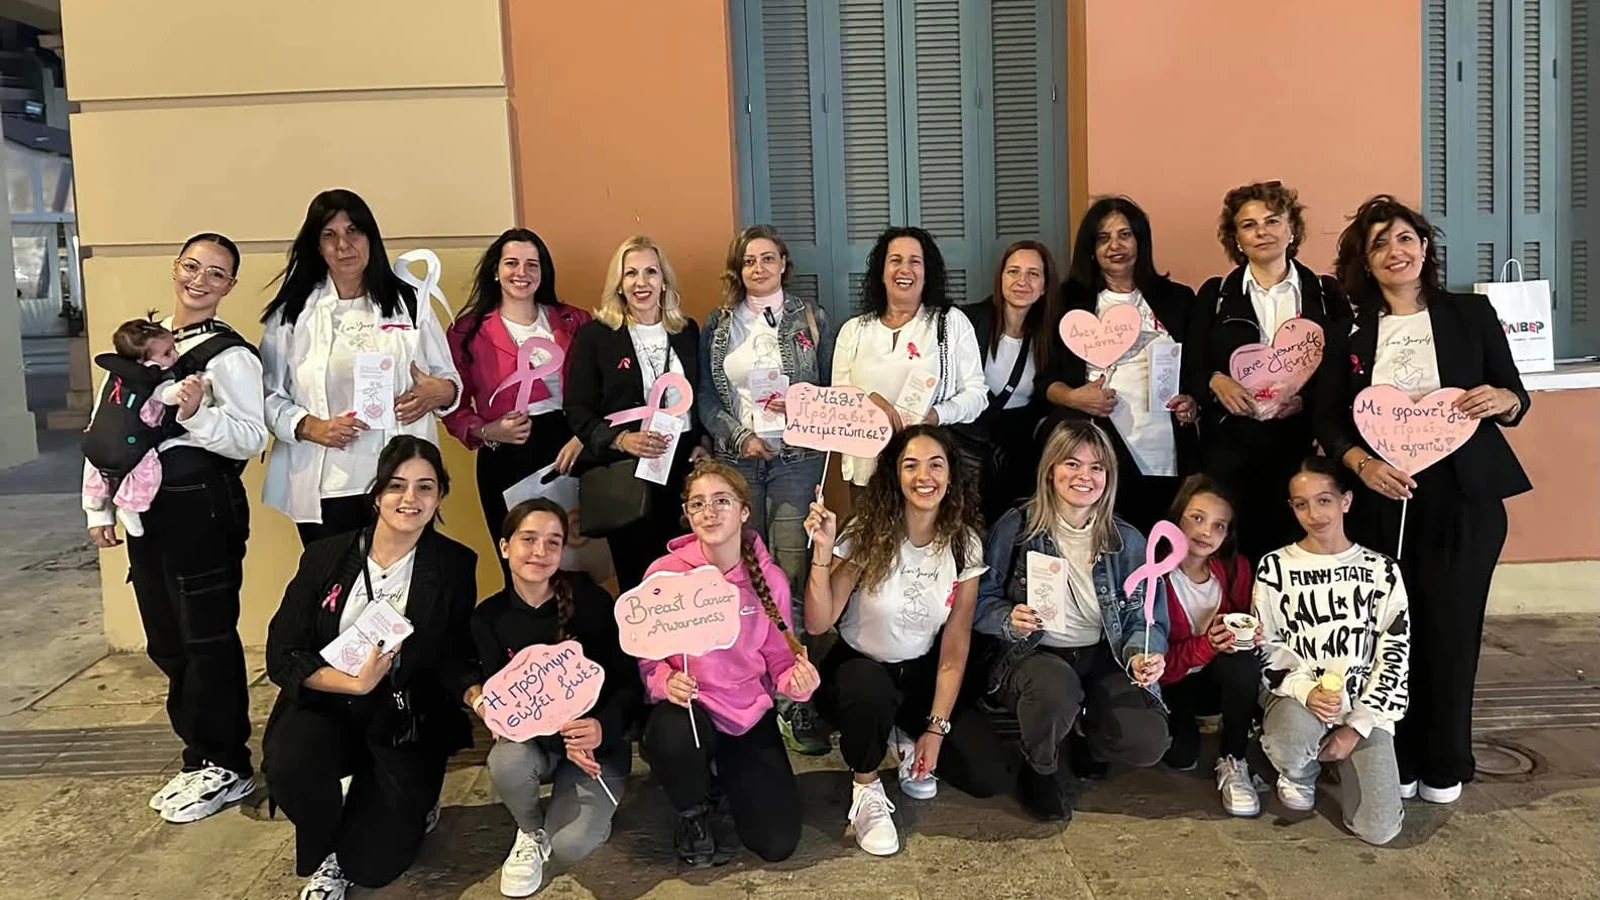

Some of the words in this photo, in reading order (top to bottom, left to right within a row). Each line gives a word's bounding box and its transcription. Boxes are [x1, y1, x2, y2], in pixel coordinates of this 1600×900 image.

[1237, 359, 1264, 381] Love
[1267, 332, 1323, 374] yourself
[1357, 399, 1383, 416] Με
[1375, 438, 1396, 452] Με
[1289, 568, 1332, 587] FUNNY
[1334, 565, 1375, 584] STATE
[624, 592, 686, 625] Breast
[693, 587, 736, 609] Cancer
[1279, 587, 1348, 634] CALL
[1352, 584, 1386, 626] ME
[647, 610, 725, 637] Awareness
[483, 690, 507, 711] Η
